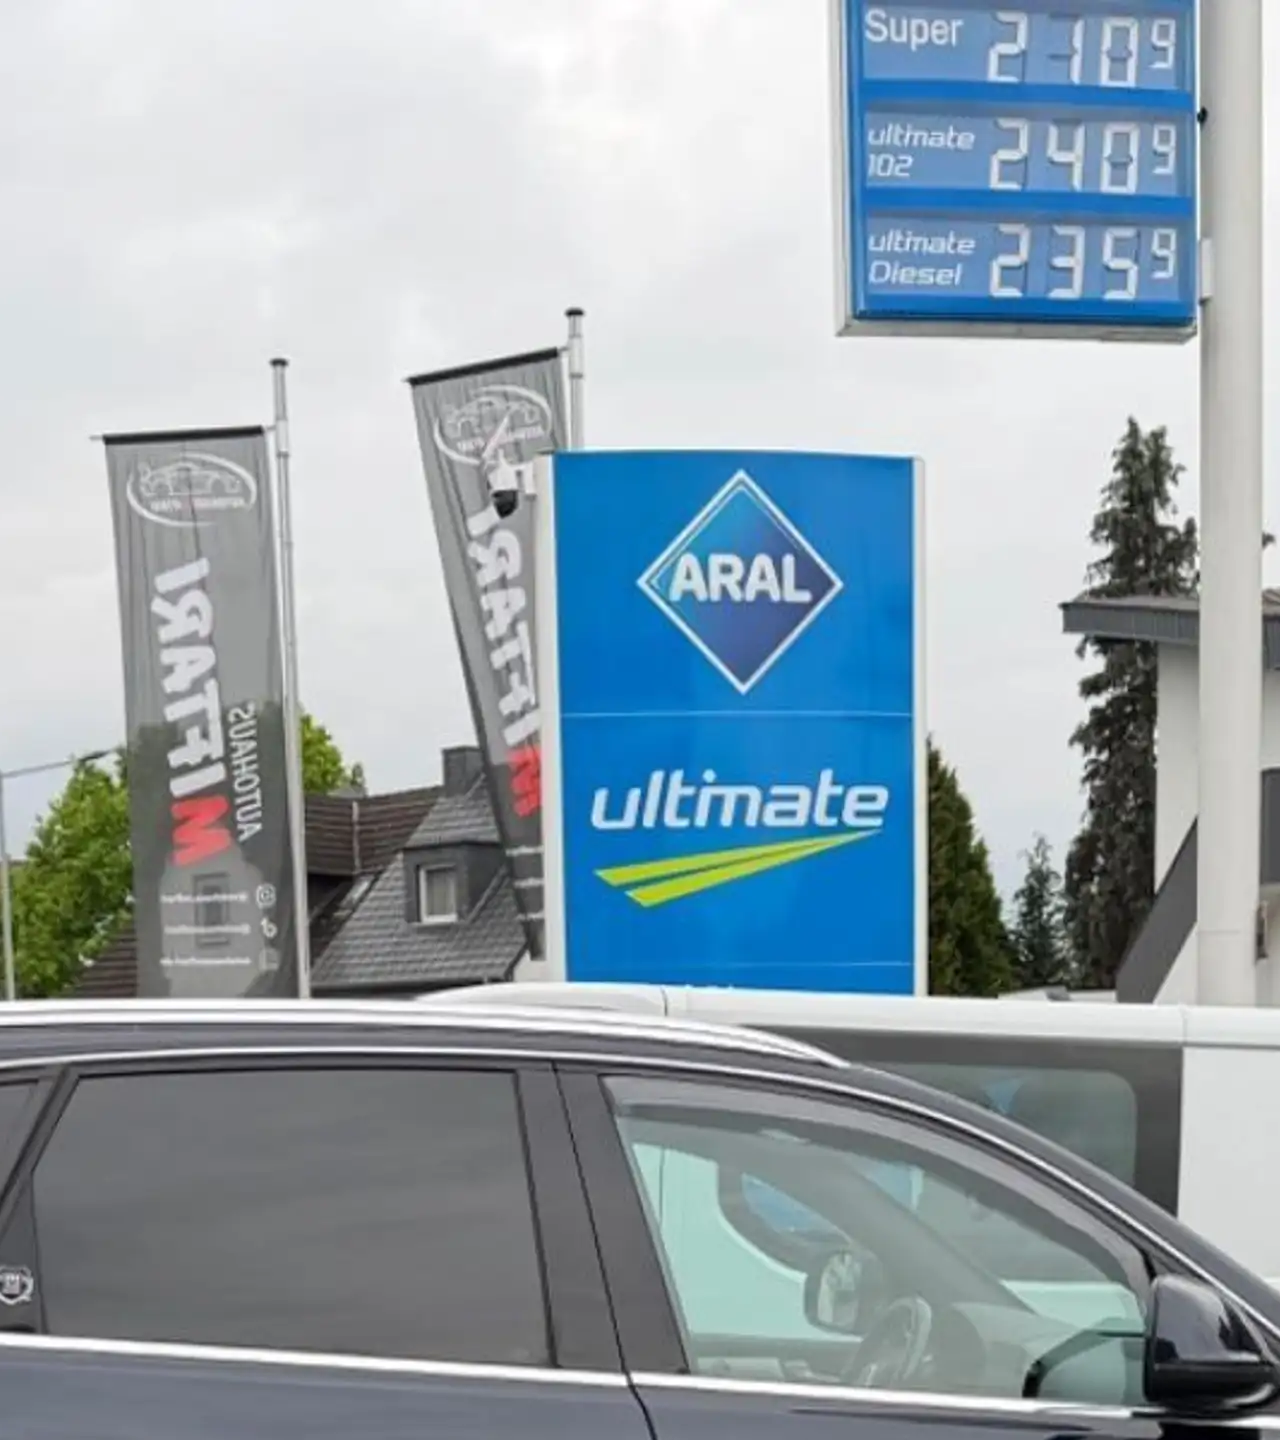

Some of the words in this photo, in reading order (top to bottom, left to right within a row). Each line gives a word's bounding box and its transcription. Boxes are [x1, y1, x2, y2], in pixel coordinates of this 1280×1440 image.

[865, 9, 963, 51] Super
[868, 154, 913, 178] 102
[869, 261, 962, 285] Diesel
[669, 552, 812, 604] ARAL
[591, 768, 888, 830] ultimate
